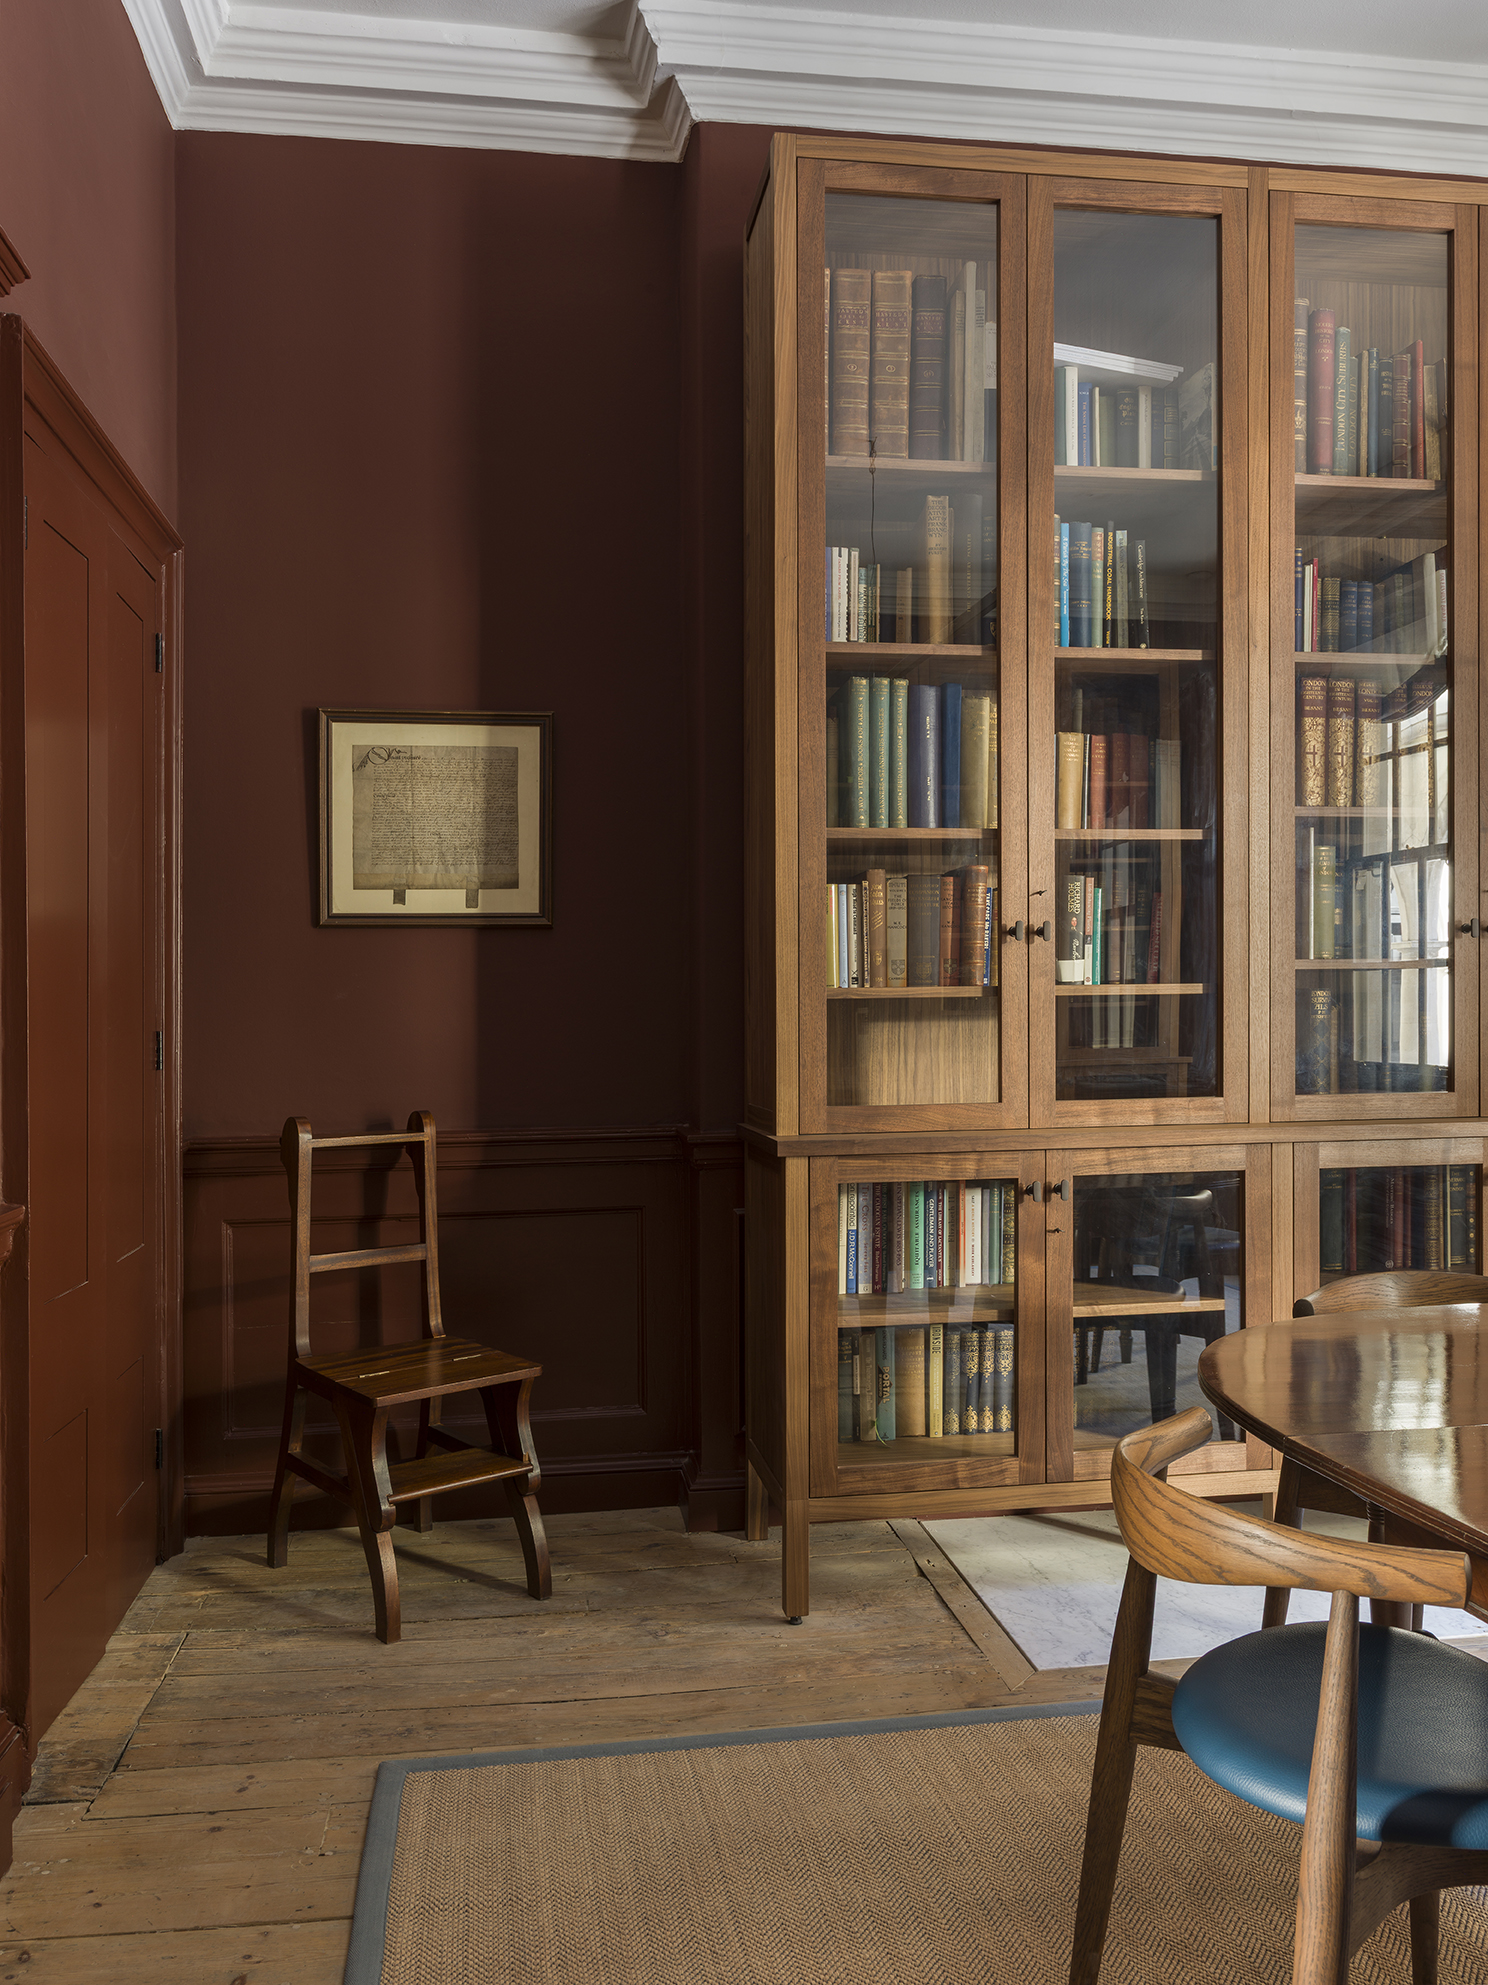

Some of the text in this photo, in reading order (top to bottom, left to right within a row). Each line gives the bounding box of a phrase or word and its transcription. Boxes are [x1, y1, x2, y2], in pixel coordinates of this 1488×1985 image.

[1335, 341, 1347, 452] LONDON CITY SUBURBS
[1348, 374, 1357, 458] LONDON CITY
[1061, 542, 1069, 559] Parish
[1061, 559, 1069, 568] By
[857, 725, 864, 735] OF
[1067, 883, 1075, 913] HOLMES
[861, 1185, 870, 1203] THE
[848, 1193, 857, 1227] repointed
[861, 1204, 870, 1232] CROSS
[928, 1198, 936, 1234] GENTLEMAN
[848, 1248, 856, 1279] McConnell
[931, 1326, 942, 1354] IRONSIDE
[882, 1366, 890, 1404] PORTAL
